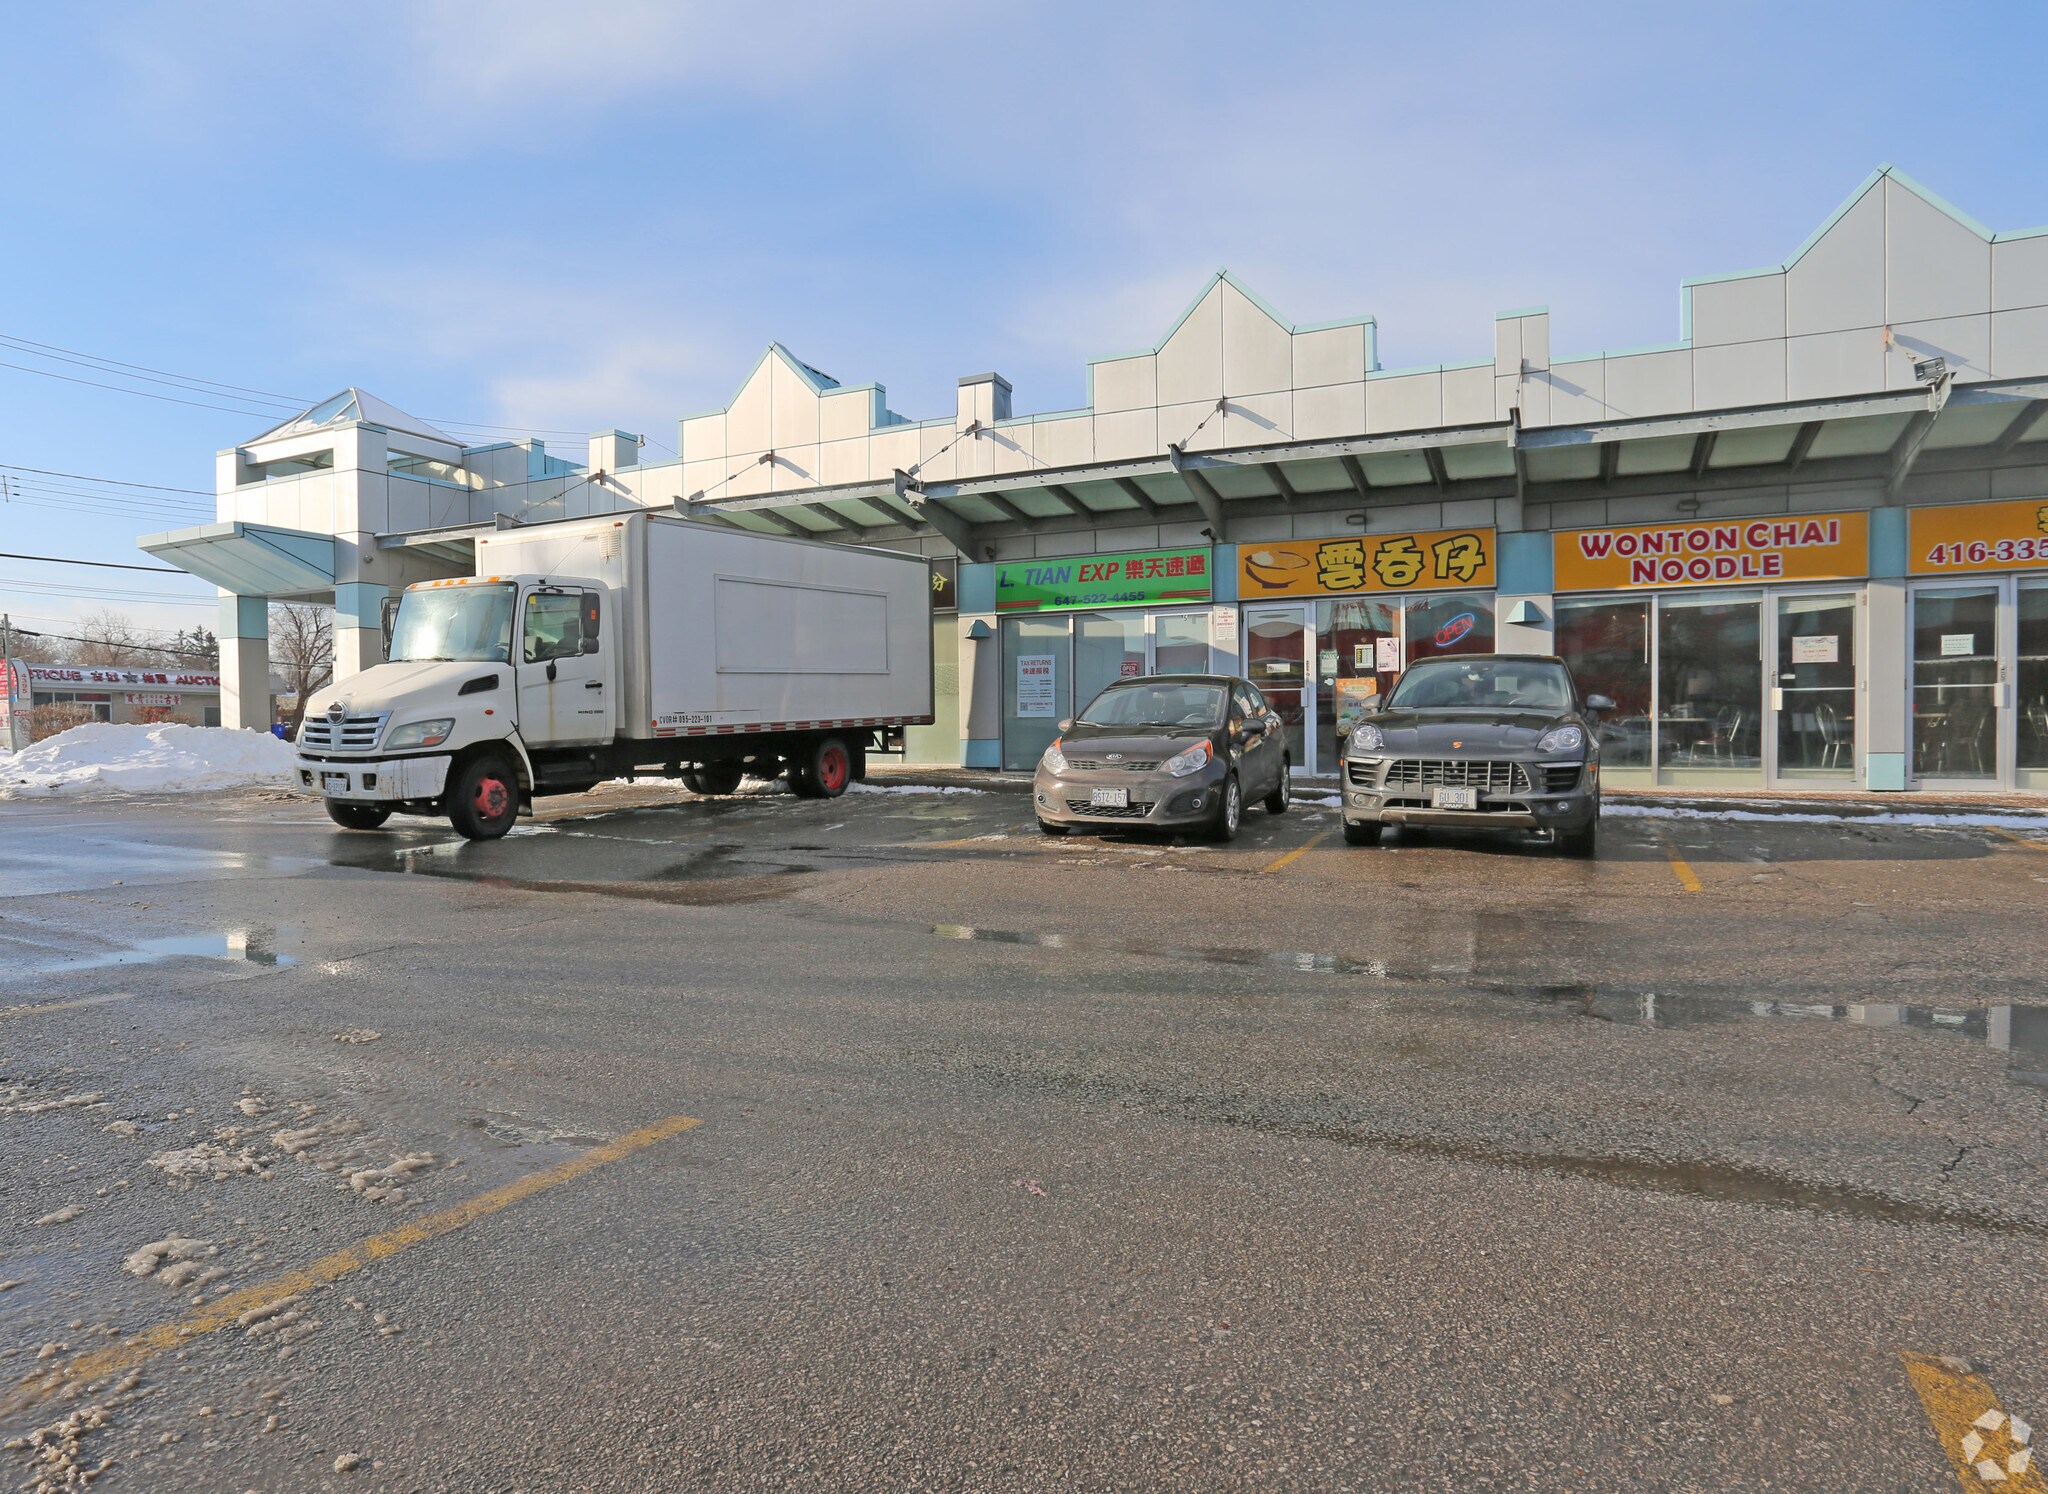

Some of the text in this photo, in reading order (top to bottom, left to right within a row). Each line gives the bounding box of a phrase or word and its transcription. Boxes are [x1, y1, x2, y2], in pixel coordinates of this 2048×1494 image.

[1579, 519, 1840, 559] WONTON CHAI
[1000, 554, 1205, 588] L. TIAN EXP 樂天速遞
[1315, 533, 1487, 590] 雲吞仔
[1631, 552, 1782, 584] NOODLE
[1054, 591, 1145, 606] 647-522-4455
[1435, 614, 1474, 644] OPEN
